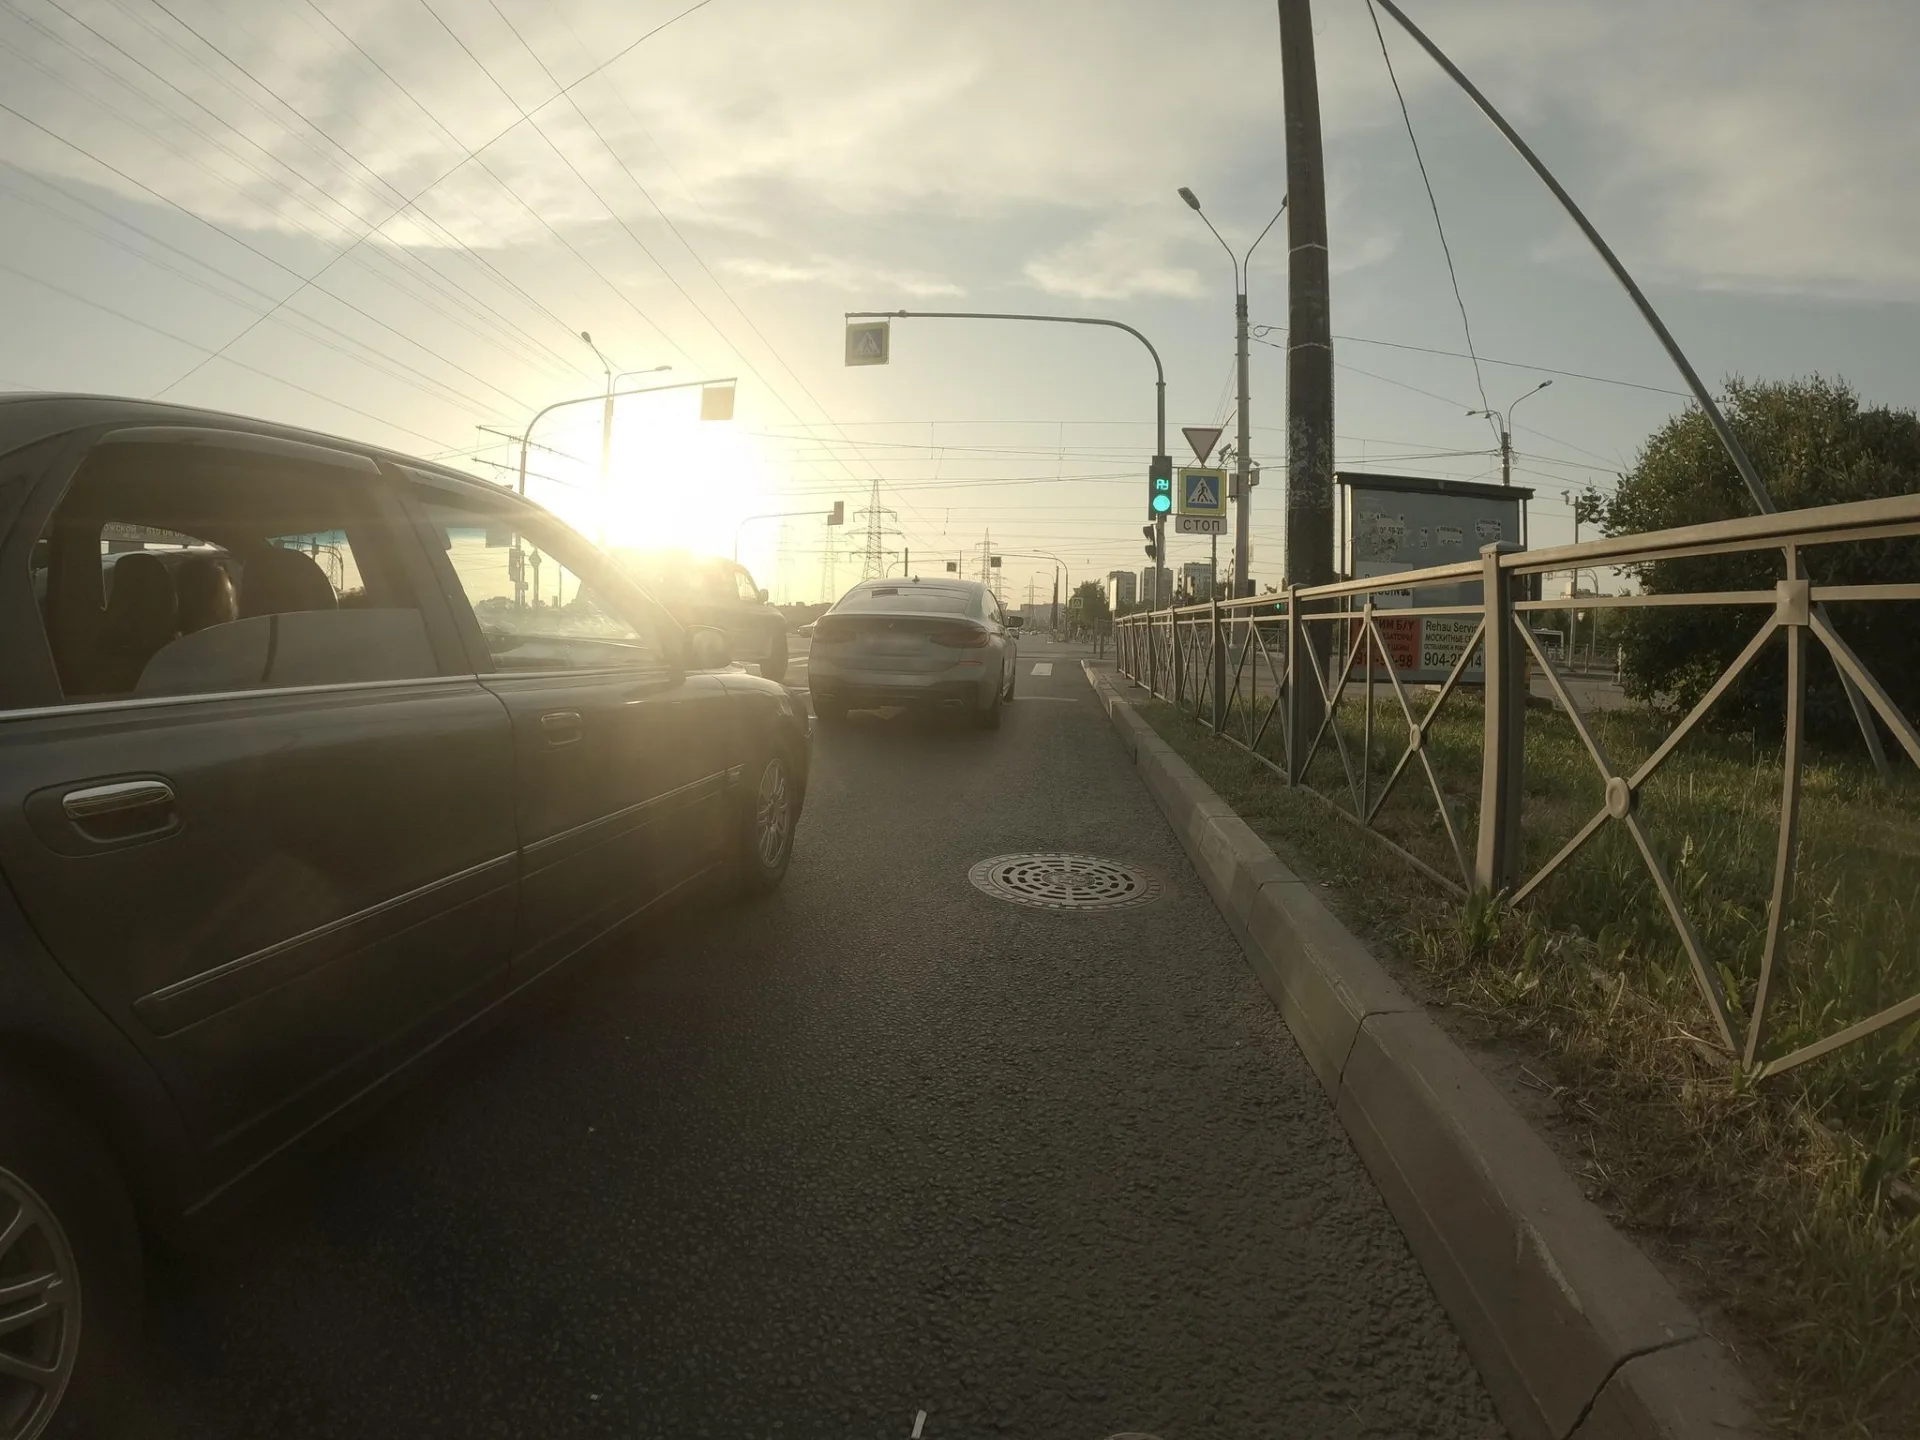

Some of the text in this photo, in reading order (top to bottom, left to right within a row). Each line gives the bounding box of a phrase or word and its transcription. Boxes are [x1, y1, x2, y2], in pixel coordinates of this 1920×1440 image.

[1183, 519, 1220, 532] СТОП
[1425, 620, 1479, 633] Rehau Servic
